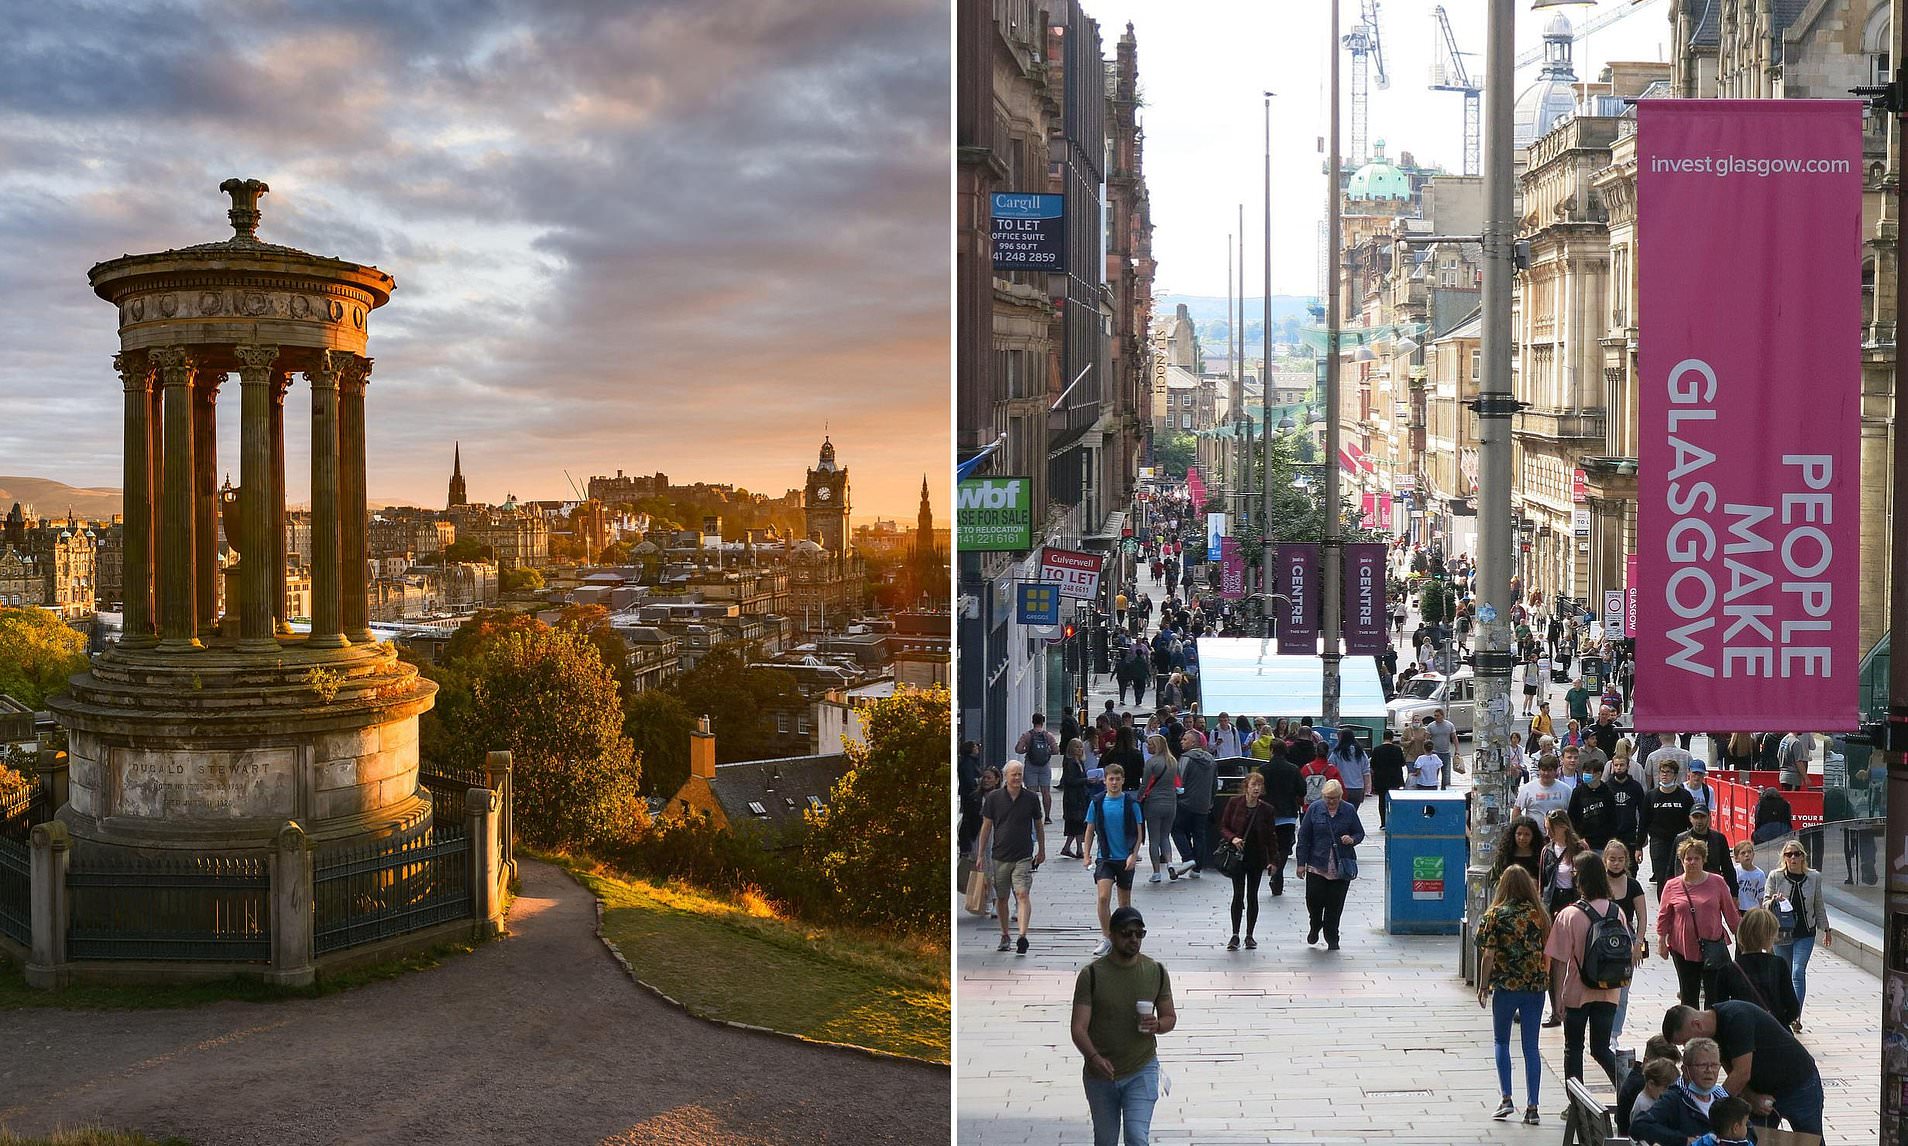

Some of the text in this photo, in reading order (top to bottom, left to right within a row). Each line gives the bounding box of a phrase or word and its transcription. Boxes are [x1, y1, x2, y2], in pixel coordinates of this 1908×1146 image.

[996, 194, 1040, 212] Cargill
[997, 220, 1040, 231] TO LET
[991, 232, 1045, 241] OFFICE SUITE
[1005, 252, 1026, 262] 248
[1028, 253, 1056, 262] 2859
[1156, 347, 1166, 393] NOCH
[957, 481, 1020, 509] wbf
[978, 511, 998, 525] FOR
[1002, 510, 1028, 525] SALE
[1665, 358, 1718, 678] GLASGOW
[997, 534, 1019, 544] 6161
[1051, 554, 1094, 568] Culverwell
[1780, 454, 1833, 678] PEOPLE
[1045, 567, 1096, 586] TO LET
[1722, 503, 1774, 678] MAKE
[132, 763, 270, 775] DUGALD STEWART
